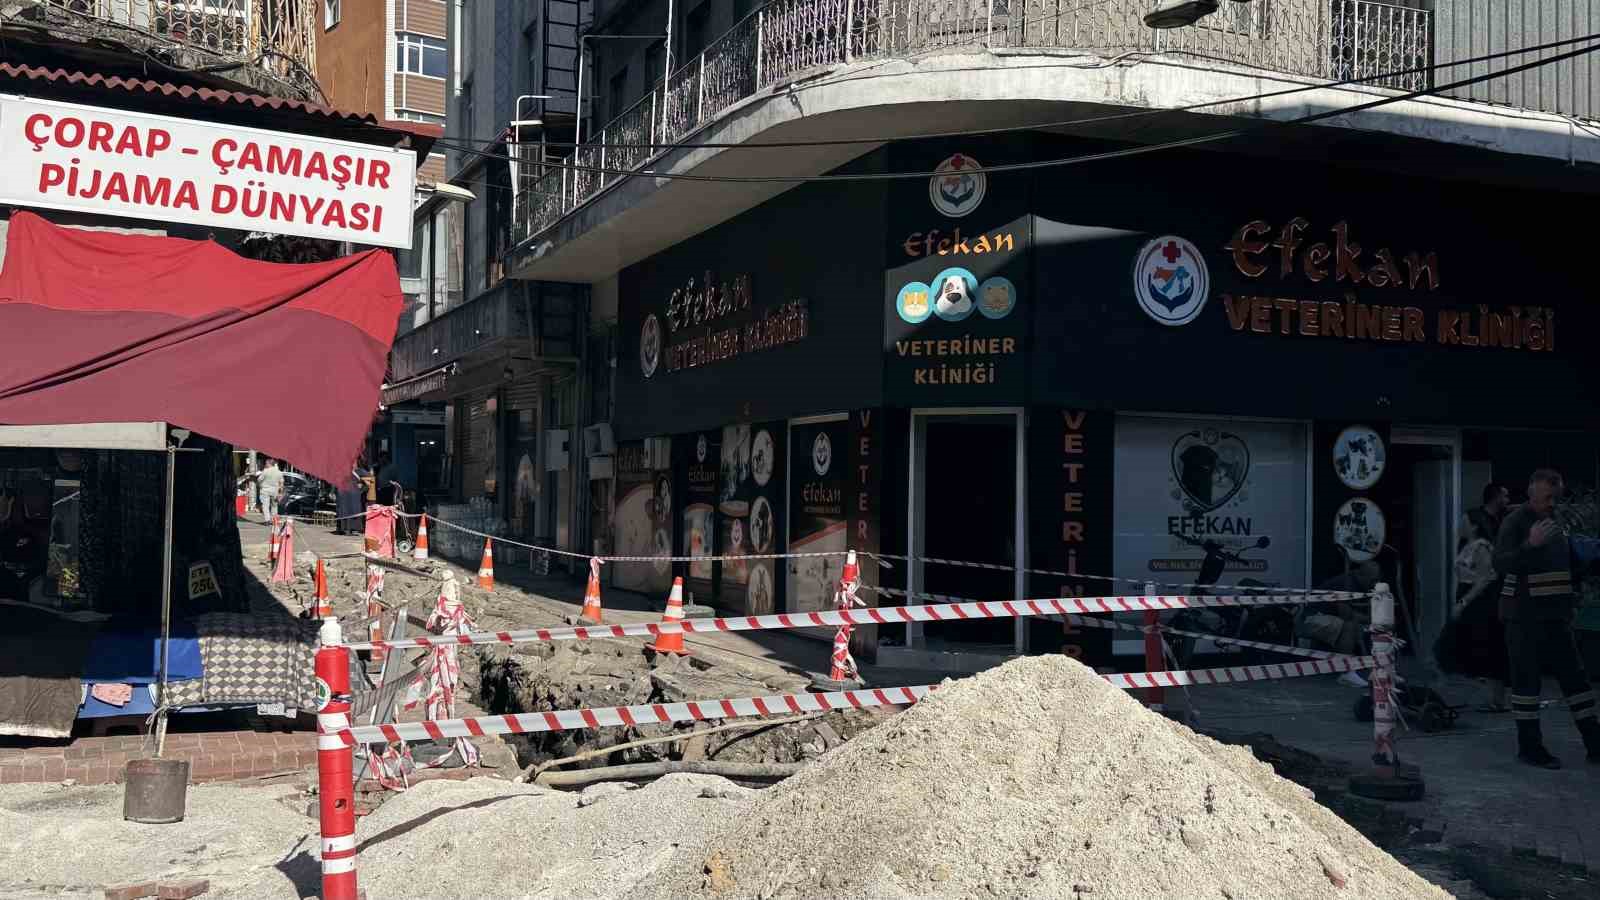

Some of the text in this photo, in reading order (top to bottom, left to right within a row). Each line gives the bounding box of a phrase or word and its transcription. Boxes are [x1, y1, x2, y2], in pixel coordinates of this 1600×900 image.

[24, 113, 171, 159] ÇORAP
[211, 138, 391, 190] ÇAMAŞIR
[38, 157, 383, 233] PİJAMA DÜNYASI
[902, 228, 1016, 256] Efekan
[1223, 215, 1440, 291] Efekan
[1221, 291, 1555, 352] VETERİNER KLİNİĞİ
[895, 334, 1017, 357] VETERİNER
[913, 362, 995, 385] KLİNİĞİ
[1167, 516, 1252, 537] EFEKAN
